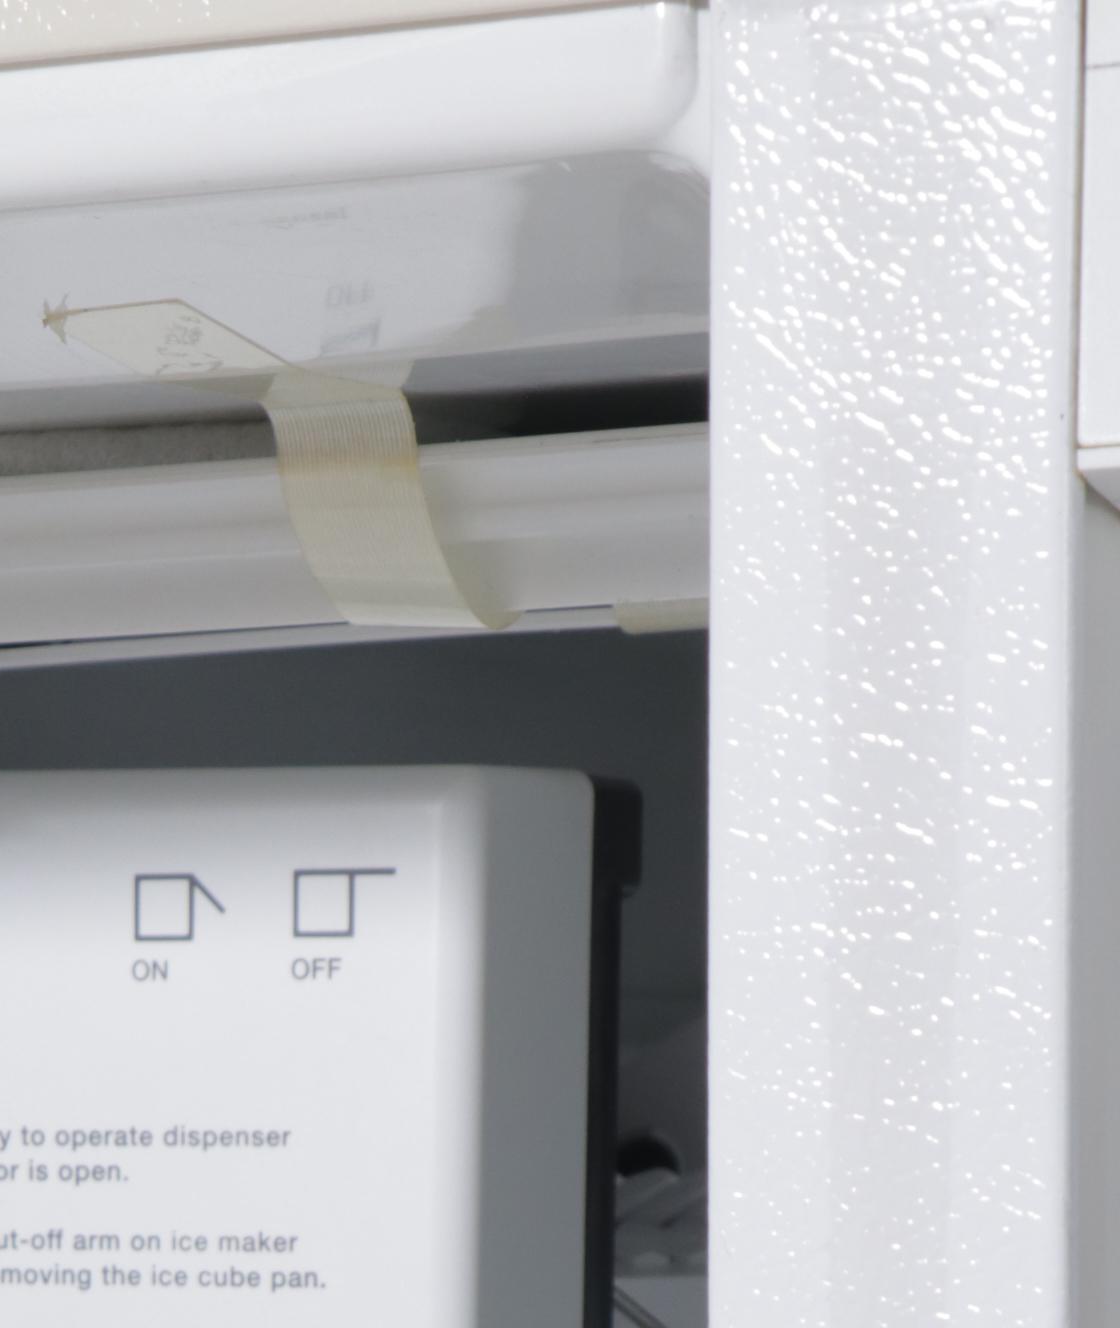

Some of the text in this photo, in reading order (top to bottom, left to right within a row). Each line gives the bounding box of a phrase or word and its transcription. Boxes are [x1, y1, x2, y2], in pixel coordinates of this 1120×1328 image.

[131, 956, 342, 983] ON OFF
[20, 1125, 46, 1147] to
[54, 1126, 154, 1152] operate
[162, 1125, 292, 1152] dispenser
[28, 1159, 49, 1183] is
[57, 1164, 129, 1187] open.
[72, 1233, 121, 1252] arm
[129, 1234, 161, 1252] on
[171, 1229, 208, 1253] ice
[218, 1231, 299, 1254] maker
[101, 1264, 142, 1287] the
[151, 1264, 189, 1287] ice
[197, 1265, 261, 1289] cube
[270, 1270, 326, 1293] pan.
